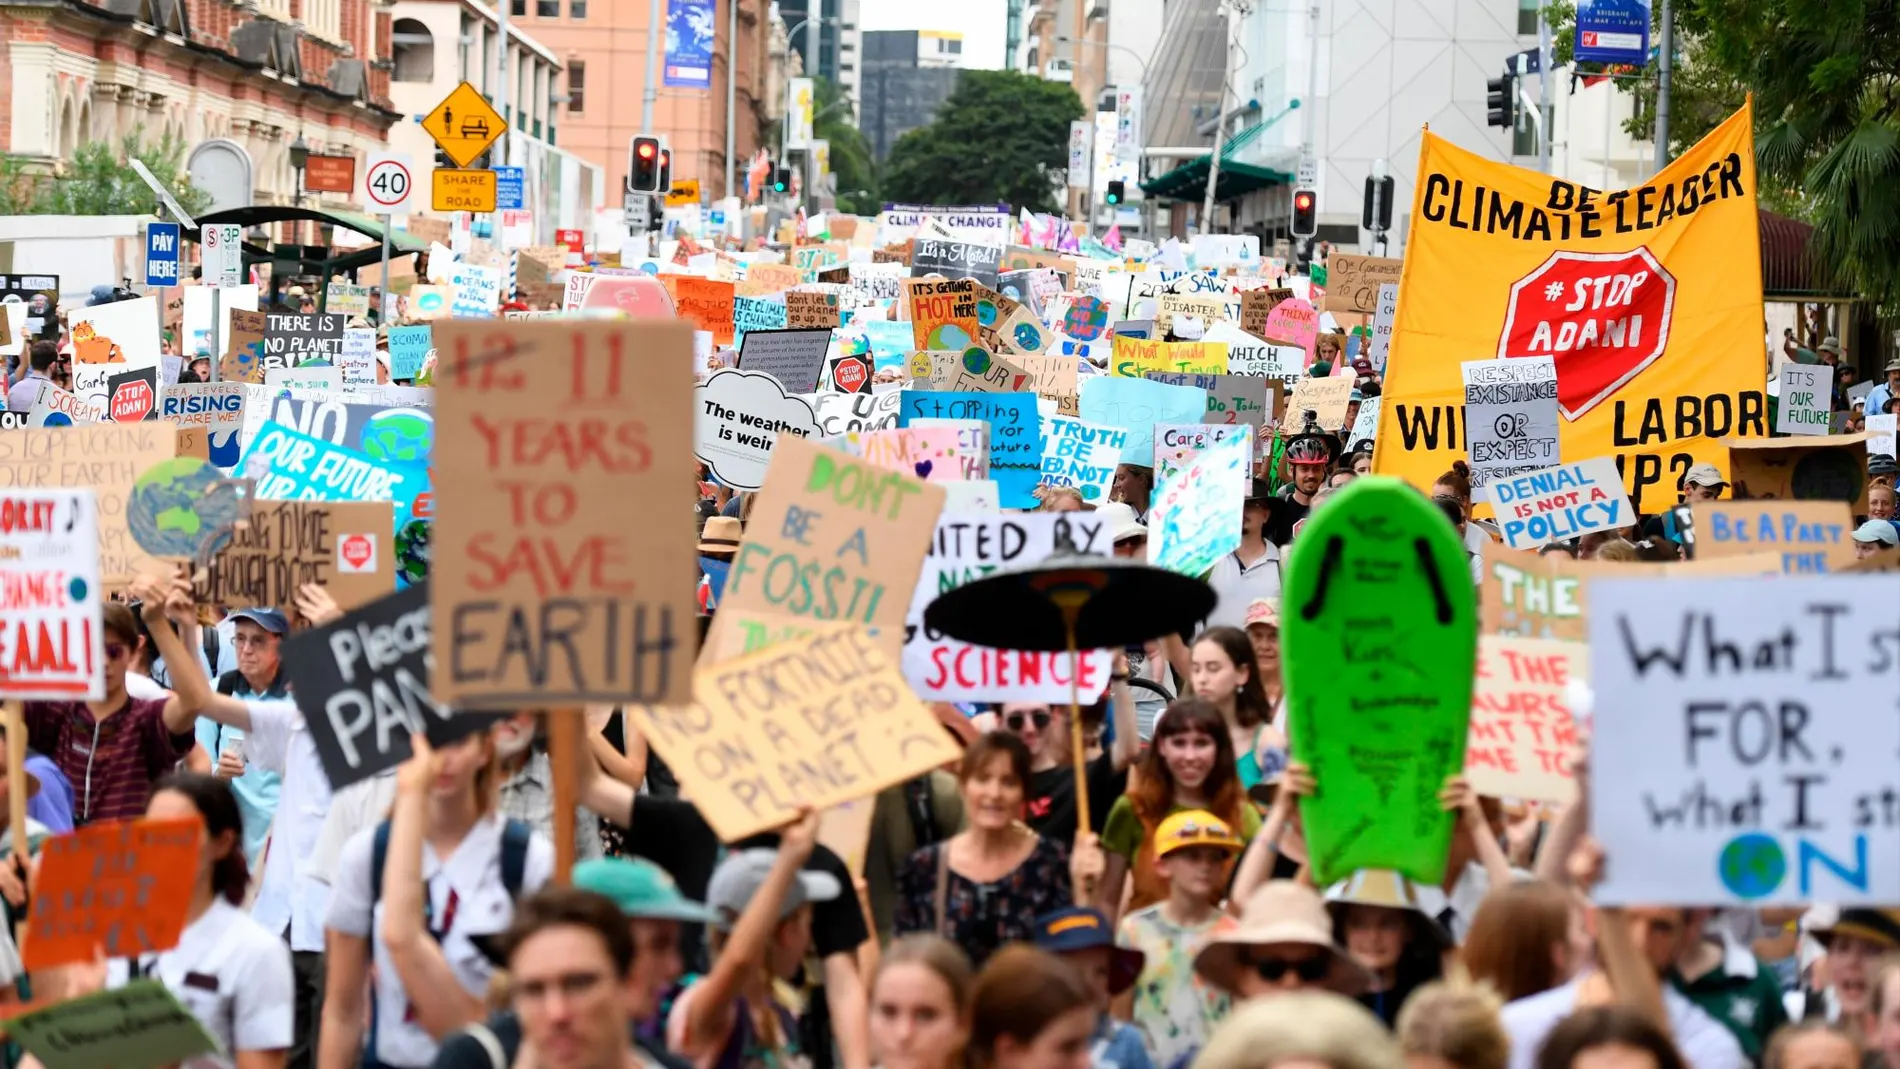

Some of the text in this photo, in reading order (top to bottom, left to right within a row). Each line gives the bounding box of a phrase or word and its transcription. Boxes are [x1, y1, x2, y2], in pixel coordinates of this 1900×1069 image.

[373, 172, 406, 194] 40
[443, 175, 486, 186] SHARE
[446, 196, 482, 207] ROAD
[1422, 152, 1744, 241] CLIMATE LEADER
[1547, 180, 1603, 214] BE
[948, 216, 1003, 228] CHANGE
[152, 234, 175, 252] PAY
[223, 228, 240, 243] 3P
[948, 244, 997, 266] Match!
[149, 260, 177, 277] HERE
[913, 283, 933, 296] IT'S
[1190, 273, 1227, 293] SAW
[754, 301, 786, 317] CLIMAT
[788, 294, 825, 305] dont let
[915, 294, 972, 320] HOT IN
[953, 303, 977, 318] HERE
[1164, 301, 1216, 315] DISASTER
[744, 313, 785, 327] CHANGING
[788, 305, 838, 317] our planet
[790, 313, 828, 324] go up in
[1280, 308, 1312, 321] THINK
[267, 315, 312, 332] THERE
[318, 315, 334, 331] IS
[1528, 315, 1643, 352] ADANI
[264, 337, 343, 354] NO PLANET
[392, 334, 428, 346] SCOMO
[1118, 339, 1206, 360] What Would
[453, 334, 527, 393] 12
[569, 330, 625, 398] 11
[840, 365, 860, 375] #STOP
[1247, 362, 1283, 371] GREEN
[1469, 362, 1555, 383] RESPECT
[307, 380, 329, 389] sure
[1195, 375, 1217, 390] Did
[1786, 371, 1815, 387] IT'S
[116, 384, 147, 400] STOP
[166, 386, 240, 397] SEA LEVELS
[1466, 380, 1557, 405] EXISTANCE
[1789, 391, 1814, 407] OUR
[49, 390, 100, 423] SCREAM
[115, 402, 147, 417] ADANI
[164, 394, 242, 415] RISING
[914, 398, 1019, 422] Stopping
[1208, 397, 1226, 412] Do
[1361, 400, 1374, 414] GO
[183, 413, 211, 424] ARE
[275, 398, 348, 446] NO
[704, 400, 810, 440] The weather
[1494, 413, 1529, 439] OR
[1613, 389, 1764, 448] LABOR
[1788, 409, 1829, 426] FUTURE
[63, 428, 157, 456] FUCKING
[718, 424, 733, 440] is
[1050, 419, 1127, 449] TRUTH
[1164, 429, 1204, 448] Care
[258, 431, 315, 474] OUR
[468, 411, 653, 476] YEARS
[1057, 438, 1093, 462] BE
[1473, 437, 1556, 463] EXPECT
[60, 461, 136, 486] EARTH
[1067, 463, 1114, 484] NOT
[1495, 466, 1595, 503] DENIAL
[806, 453, 923, 521] DONT
[496, 478, 580, 530] TO
[1514, 487, 1608, 519] IS NOT A
[1504, 498, 1620, 548] POLICY
[1758, 513, 1777, 542] A
[1782, 513, 1844, 543] PART
[780, 504, 869, 567] BE A
[464, 530, 635, 600] SAVE
[1493, 565, 1581, 617] THE
[450, 597, 678, 698] EARTH
[1615, 602, 1851, 682] What I
[925, 644, 1097, 690] SCIENCE
[1500, 649, 1569, 687] THE
[645, 701, 713, 747] NO
[716, 624, 886, 722] FORTNITE
[694, 682, 899, 782] ON A DEAD
[730, 730, 877, 819] PLANET
[1782, 773, 1828, 831] I
